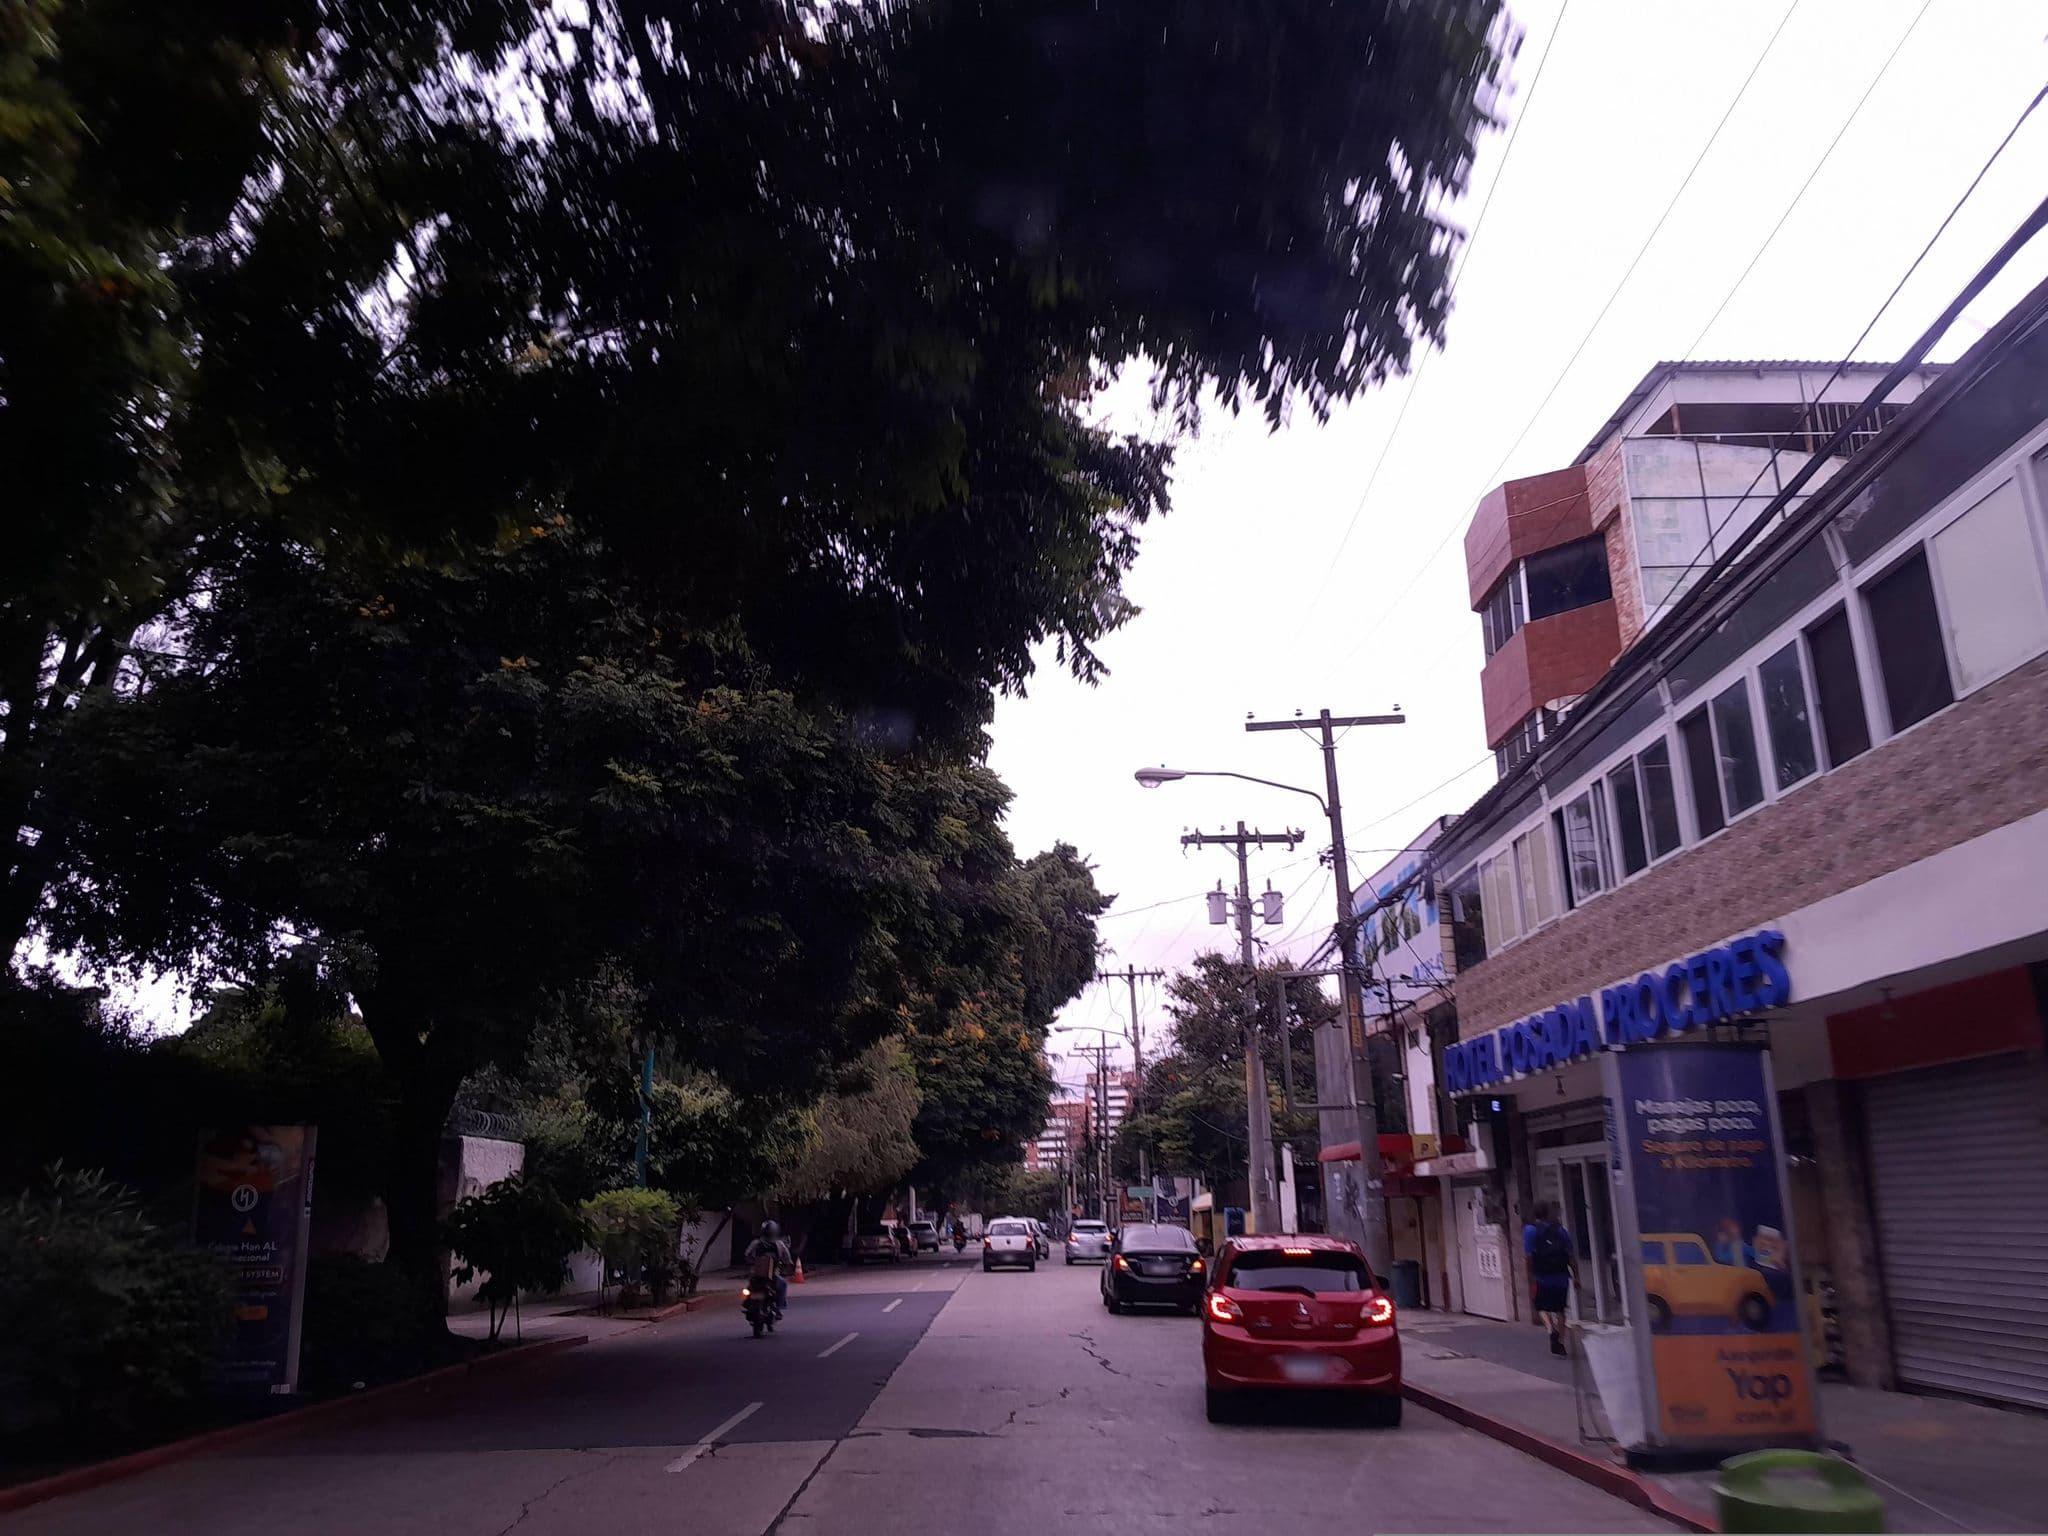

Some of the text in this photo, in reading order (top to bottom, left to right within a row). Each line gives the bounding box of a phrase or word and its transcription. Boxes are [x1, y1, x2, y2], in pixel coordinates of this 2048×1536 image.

[1444, 930, 1791, 1095] HOTEL POSADA PROCERES
[1634, 1097, 1713, 1116] Manejas
[1646, 1117, 1707, 1134] pagas
[241, 1241, 261, 1252] Han
[1726, 1367, 1793, 1408] Yap
